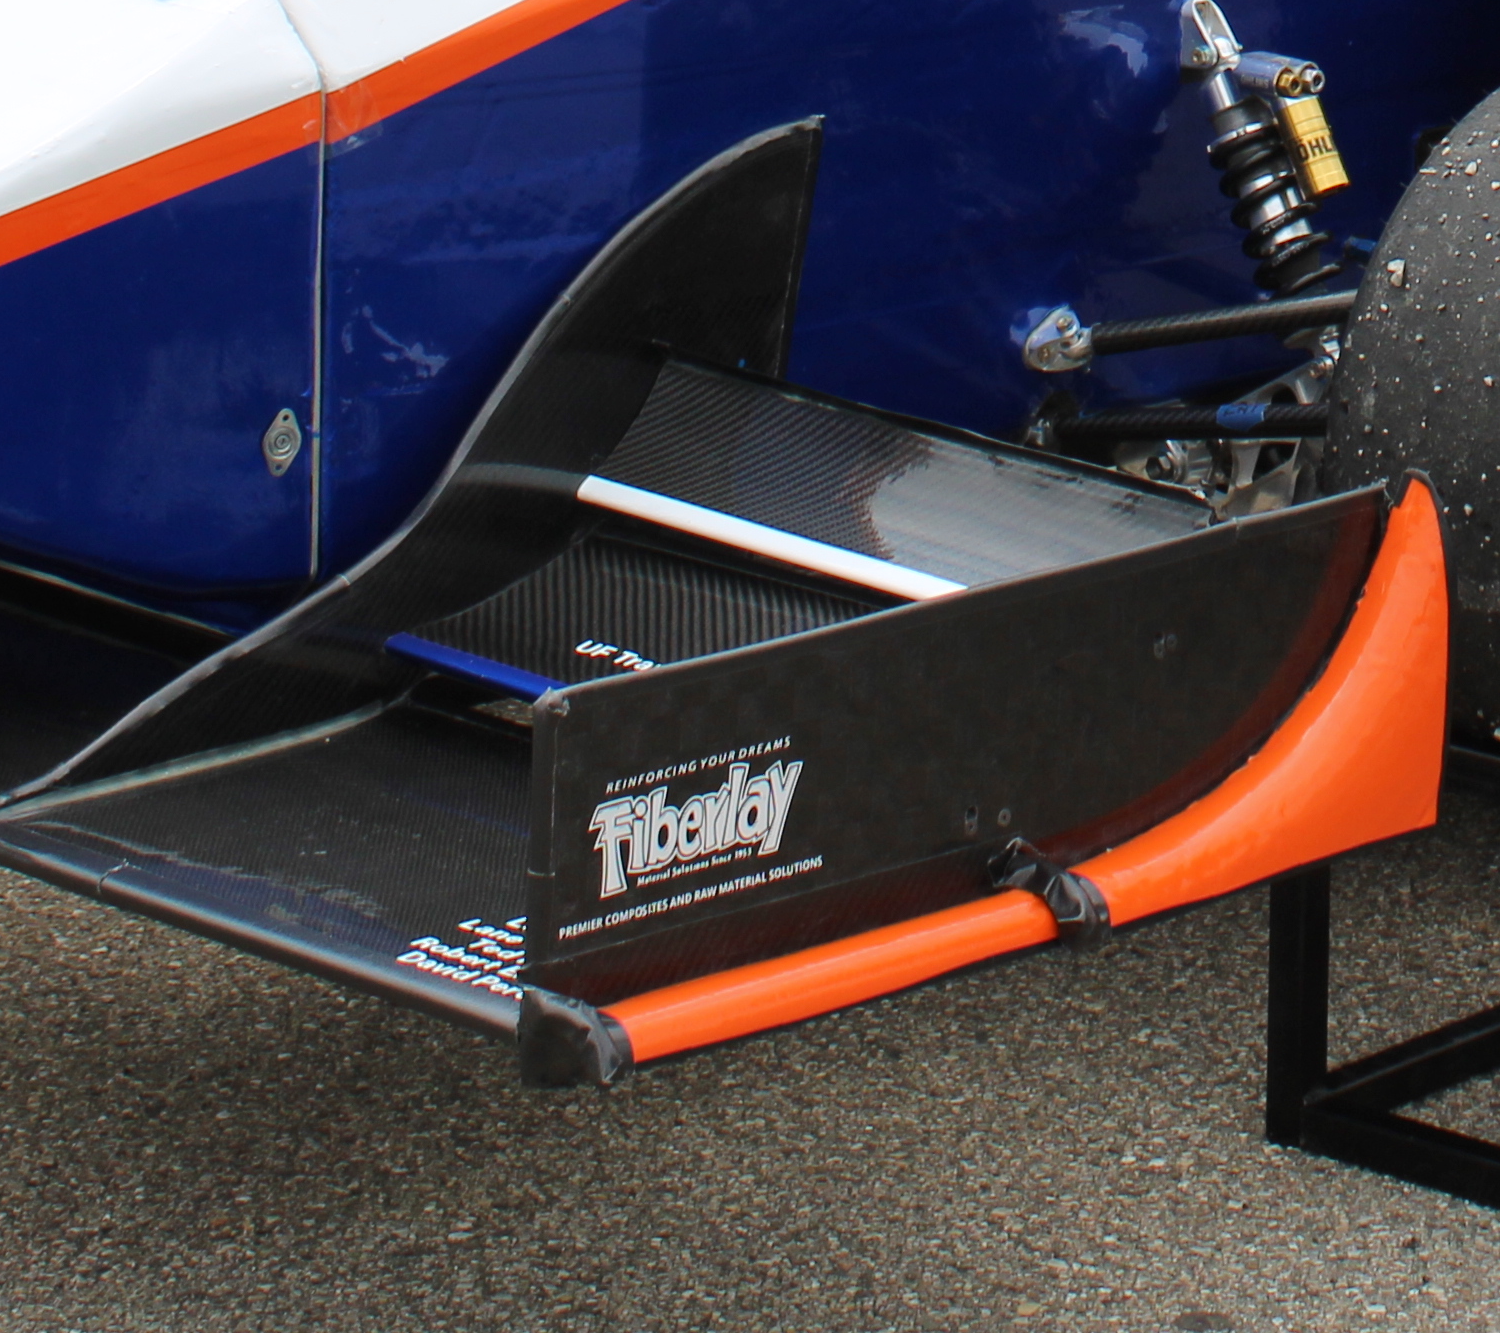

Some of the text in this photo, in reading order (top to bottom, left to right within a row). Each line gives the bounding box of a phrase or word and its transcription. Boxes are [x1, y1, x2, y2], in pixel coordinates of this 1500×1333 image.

[575, 639, 661, 671] UF Tra
[606, 736, 791, 794] REINFORCING YOUR DREAMS
[589, 761, 803, 899] Fiberlay
[636, 868, 670, 887] Material
[711, 853, 732, 868] Since
[559, 855, 823, 940] PREMIER COMPOSITES AND RAW MATERIAL SOLUTIONS
[396, 949, 482, 982] David
[409, 935, 503, 971] Robert
